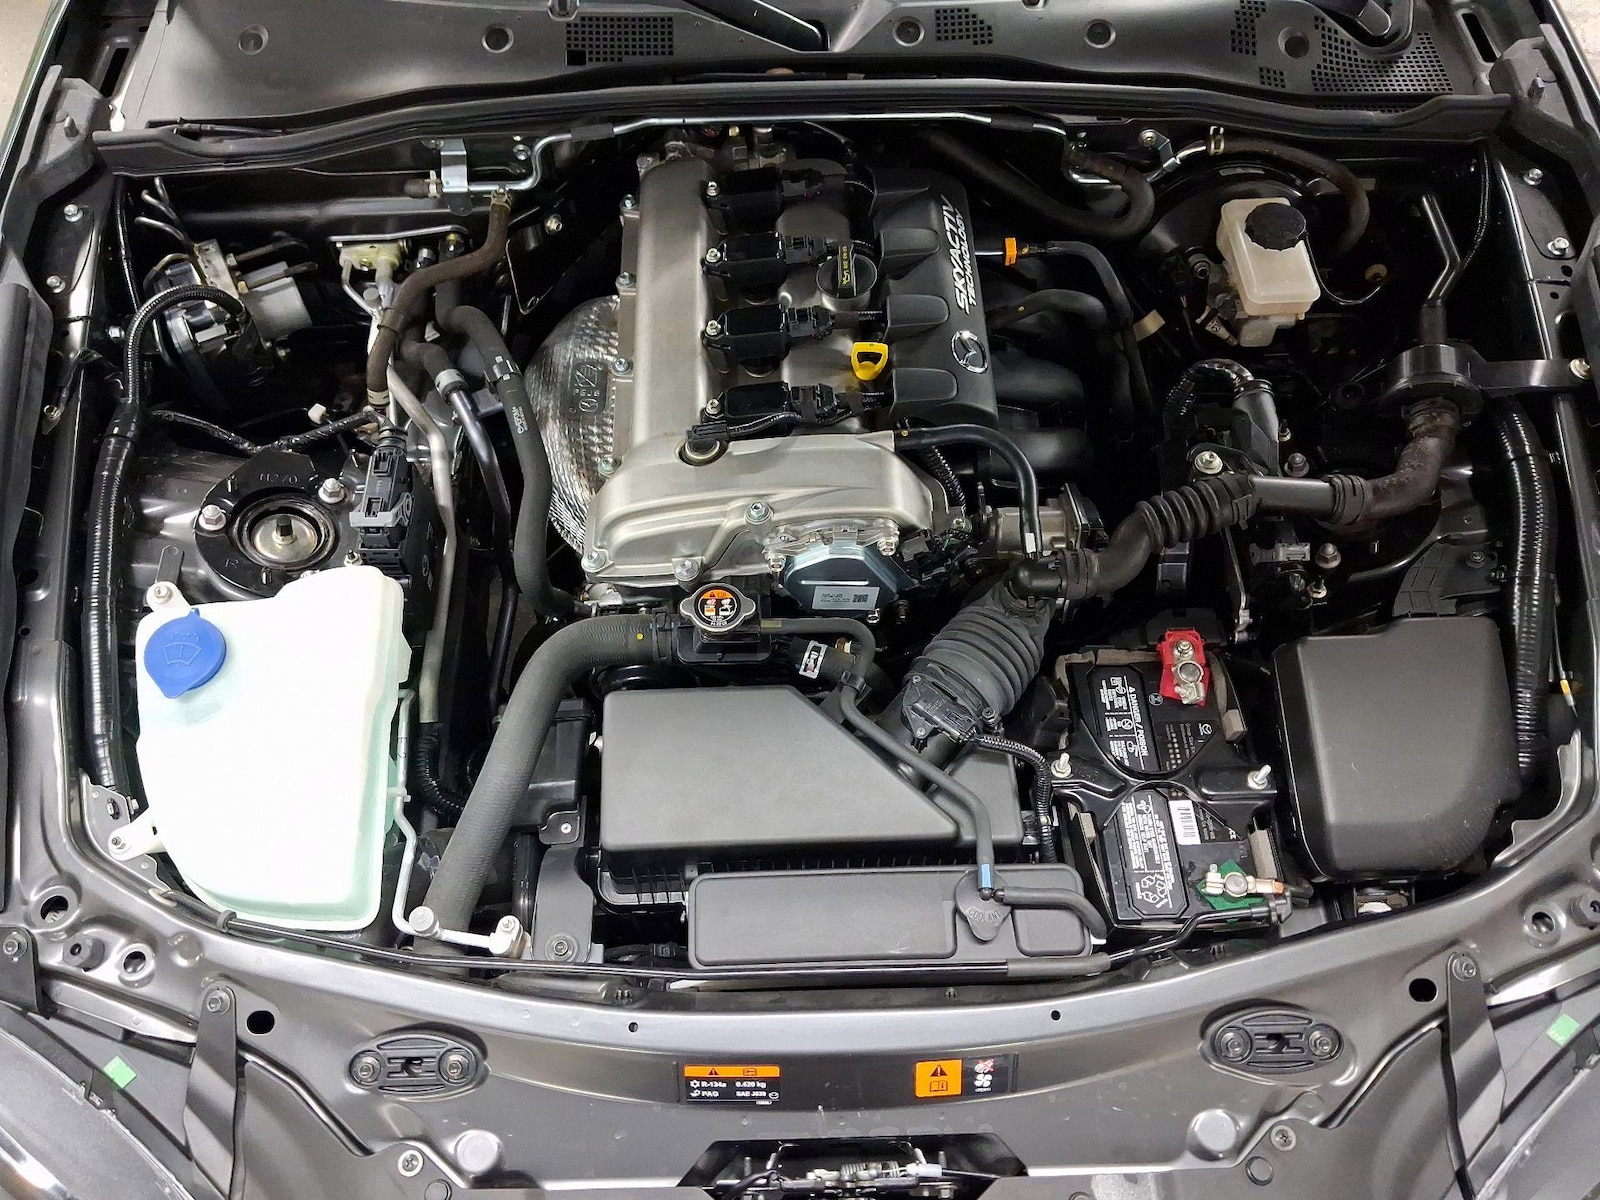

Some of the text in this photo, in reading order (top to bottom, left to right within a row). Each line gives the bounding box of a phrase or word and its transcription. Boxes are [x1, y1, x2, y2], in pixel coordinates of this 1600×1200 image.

[941, 194, 970, 315] SKYACTIV
[955, 208, 977, 306] TECHNOLOGY
[1129, 693, 1142, 723] DANGER
[1137, 729, 1149, 757] POISON
[701, 1090, 719, 1098] PAG
[756, 1080, 767, 1089] kg
